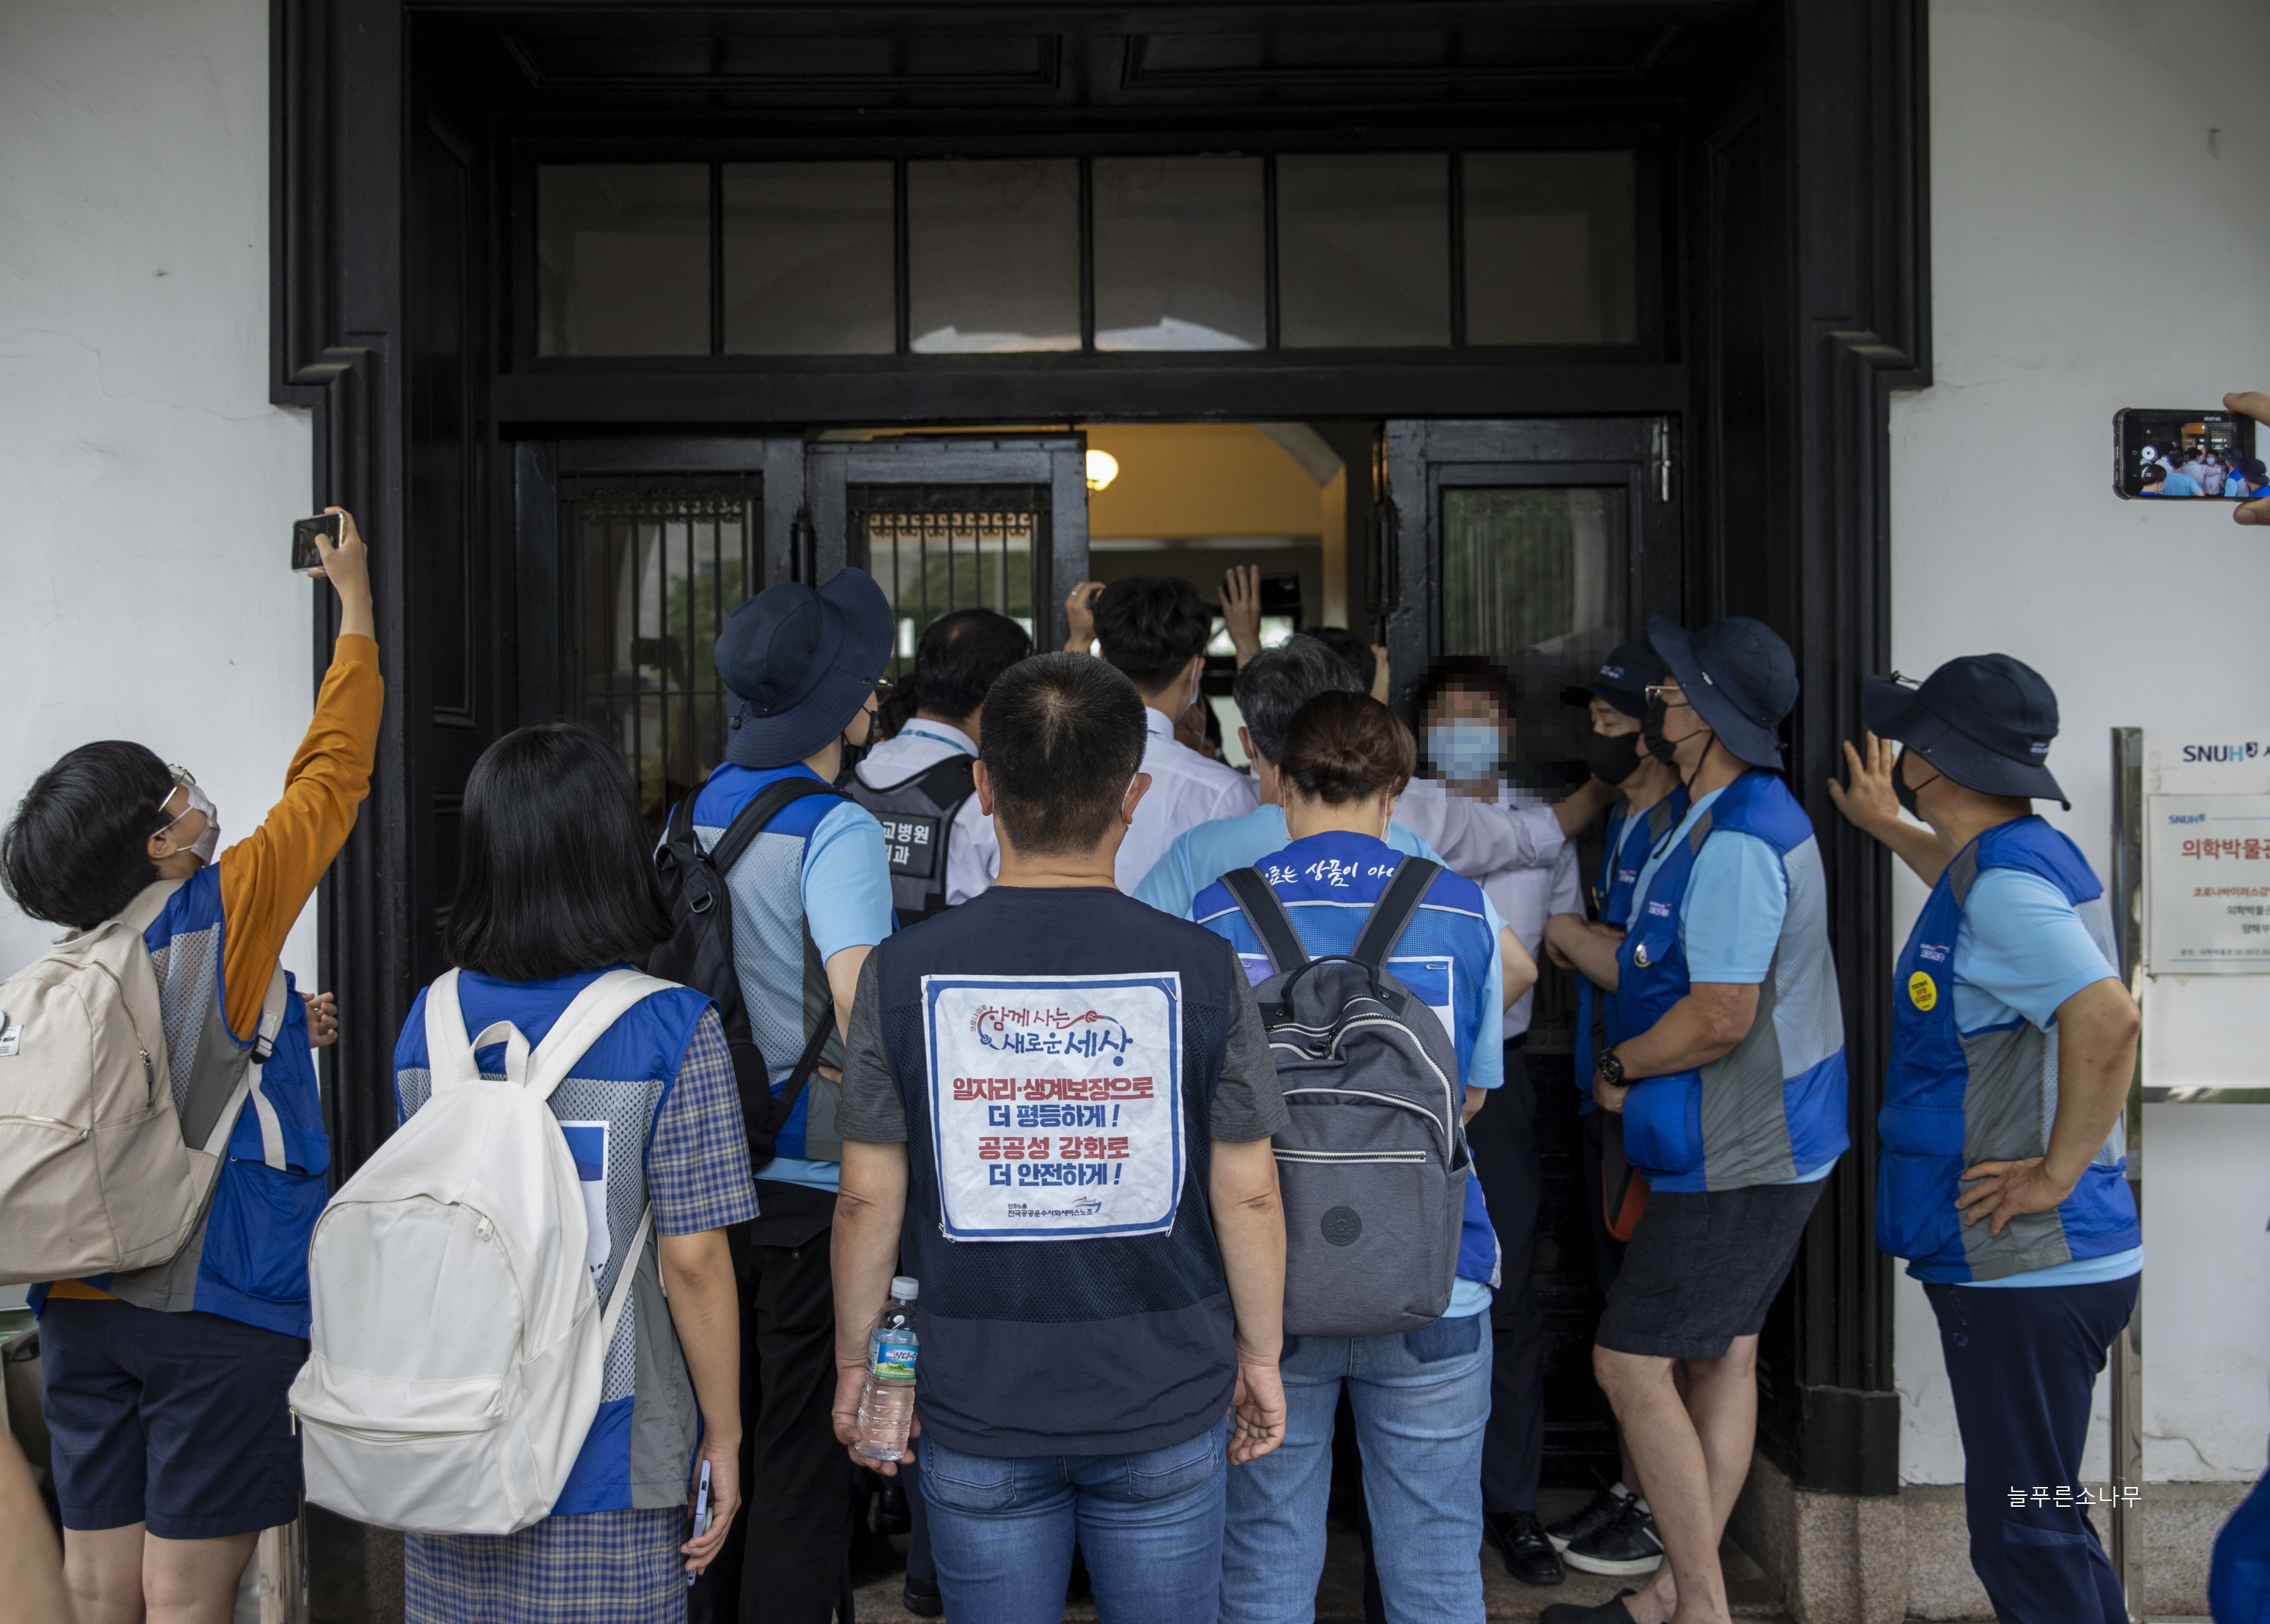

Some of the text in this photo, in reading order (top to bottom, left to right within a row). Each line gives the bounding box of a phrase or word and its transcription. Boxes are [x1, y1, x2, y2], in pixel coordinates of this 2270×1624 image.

[2182, 745, 2244, 763] SNUH
[2167, 815, 2199, 824] SNUH
[880, 821, 929, 844] 교병원
[1265, 865, 1298, 886] 료는
[1305, 859, 1358, 887] 상품이
[989, 1006, 1071, 1031] 함께 사는
[1003, 1028, 1134, 1067] 새로운 세상
[989, 1105, 1010, 1127] 더
[1016, 1104, 1106, 1127] 평등하게
[978, 1136, 1130, 1160] 공공성 강화로
[989, 1163, 1011, 1187] 더
[1017, 1163, 1108, 1186] 안전하게
